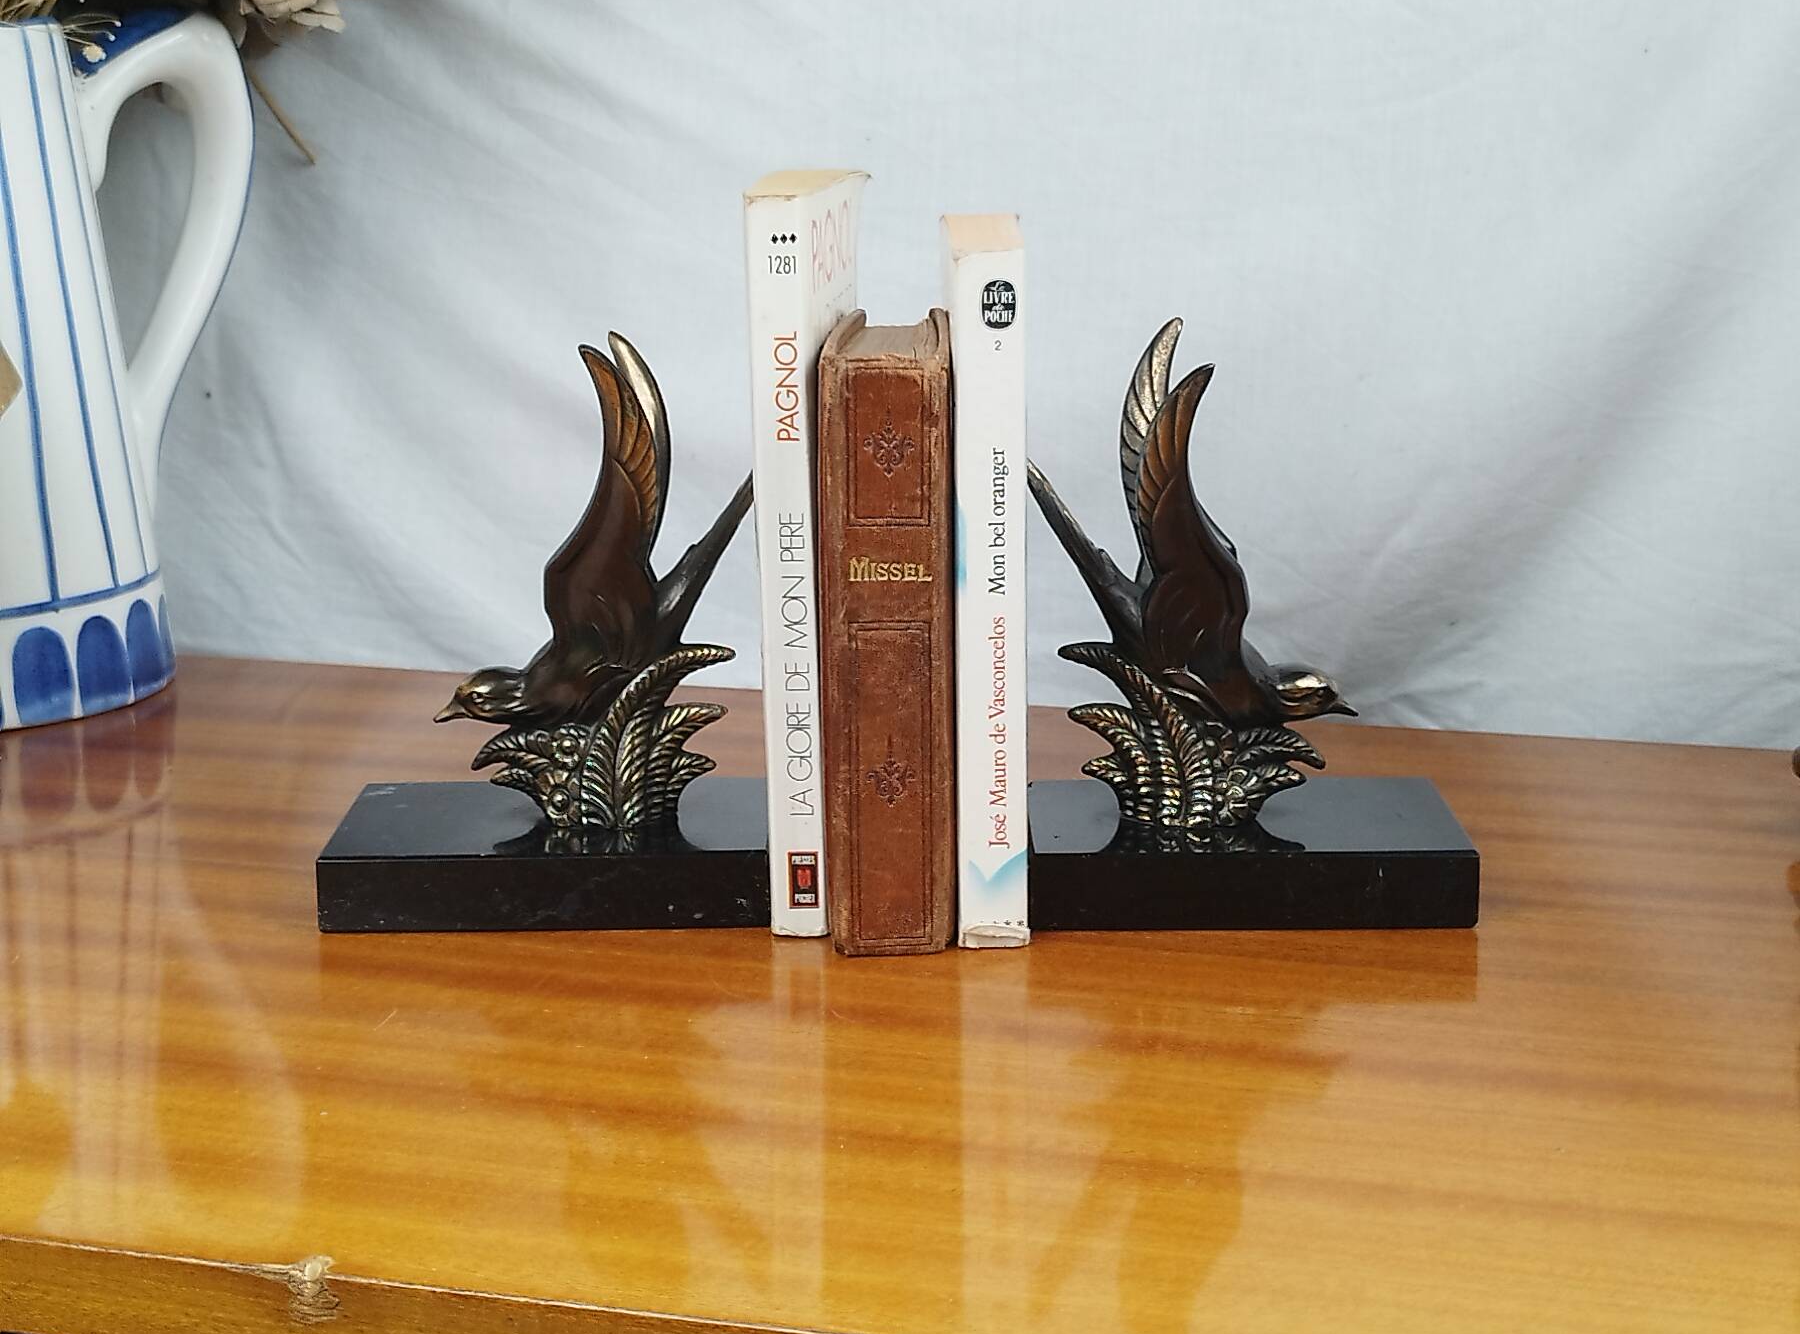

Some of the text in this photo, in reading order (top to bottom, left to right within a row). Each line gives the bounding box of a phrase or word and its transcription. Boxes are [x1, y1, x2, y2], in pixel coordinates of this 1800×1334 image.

[768, 255, 797, 275] 1281
[983, 291, 1015, 304] LIVRE
[984, 310, 1014, 323] POCHE
[994, 339, 1002, 351] 2
[773, 331, 800, 442] PAGNOL
[988, 447, 1009, 595] Mon bel oranger
[779, 513, 814, 816] LA GLOIRE DE MON PERE
[988, 616, 1010, 849] José Mauro de Vasconcelos
